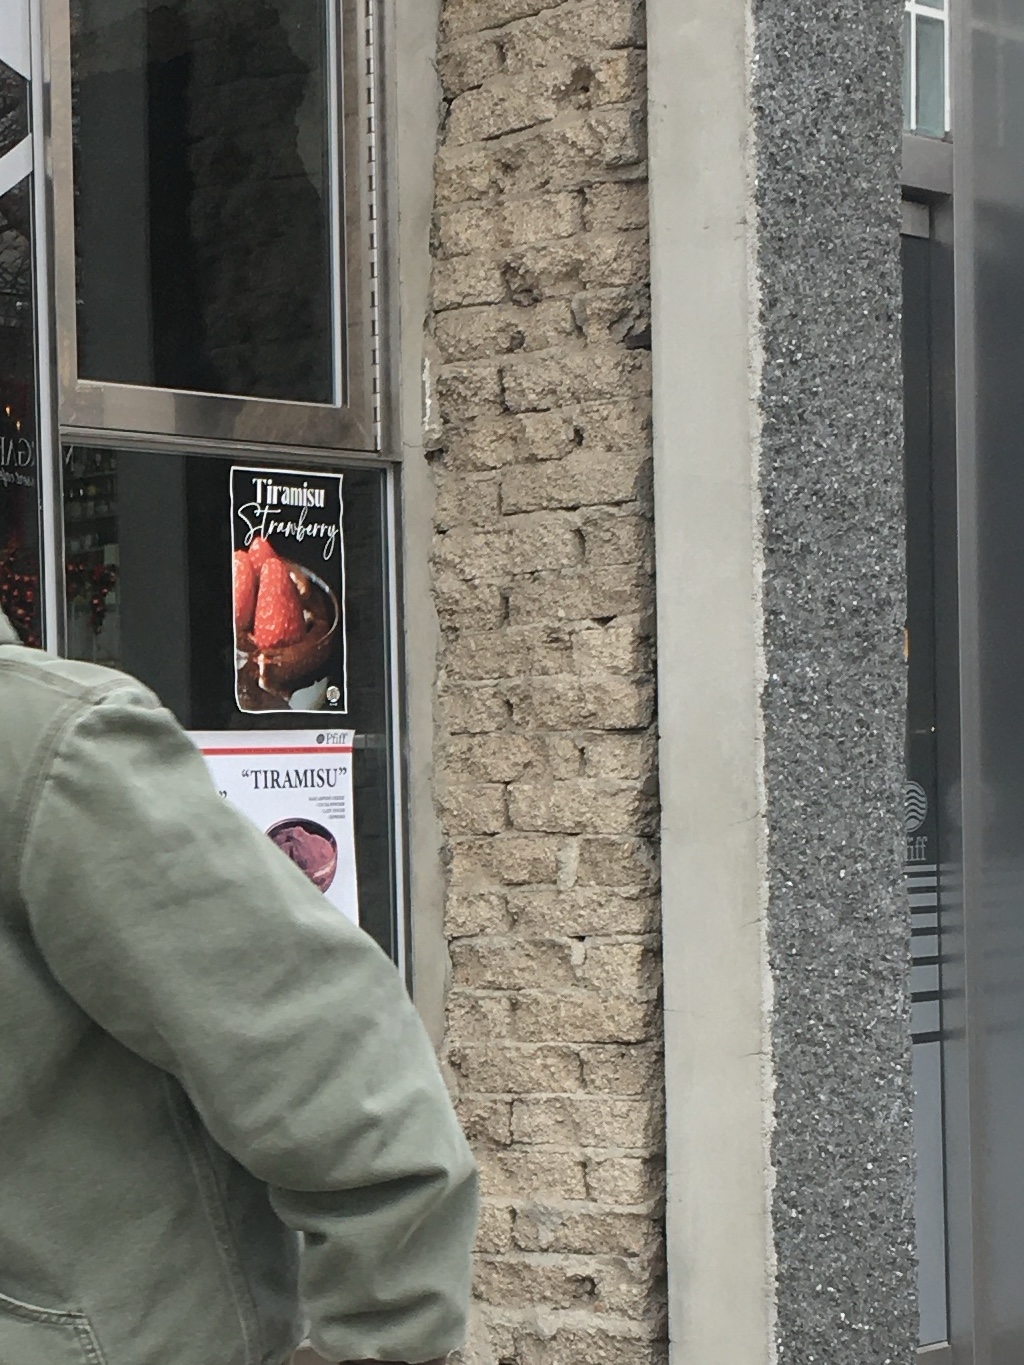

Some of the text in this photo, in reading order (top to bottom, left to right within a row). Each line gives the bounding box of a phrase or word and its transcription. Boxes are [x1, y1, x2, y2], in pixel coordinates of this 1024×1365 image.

[252, 478, 325, 508] Tiramisu
[238, 502, 339, 560] Strawberry
[326, 732, 348, 744] Pfiff
